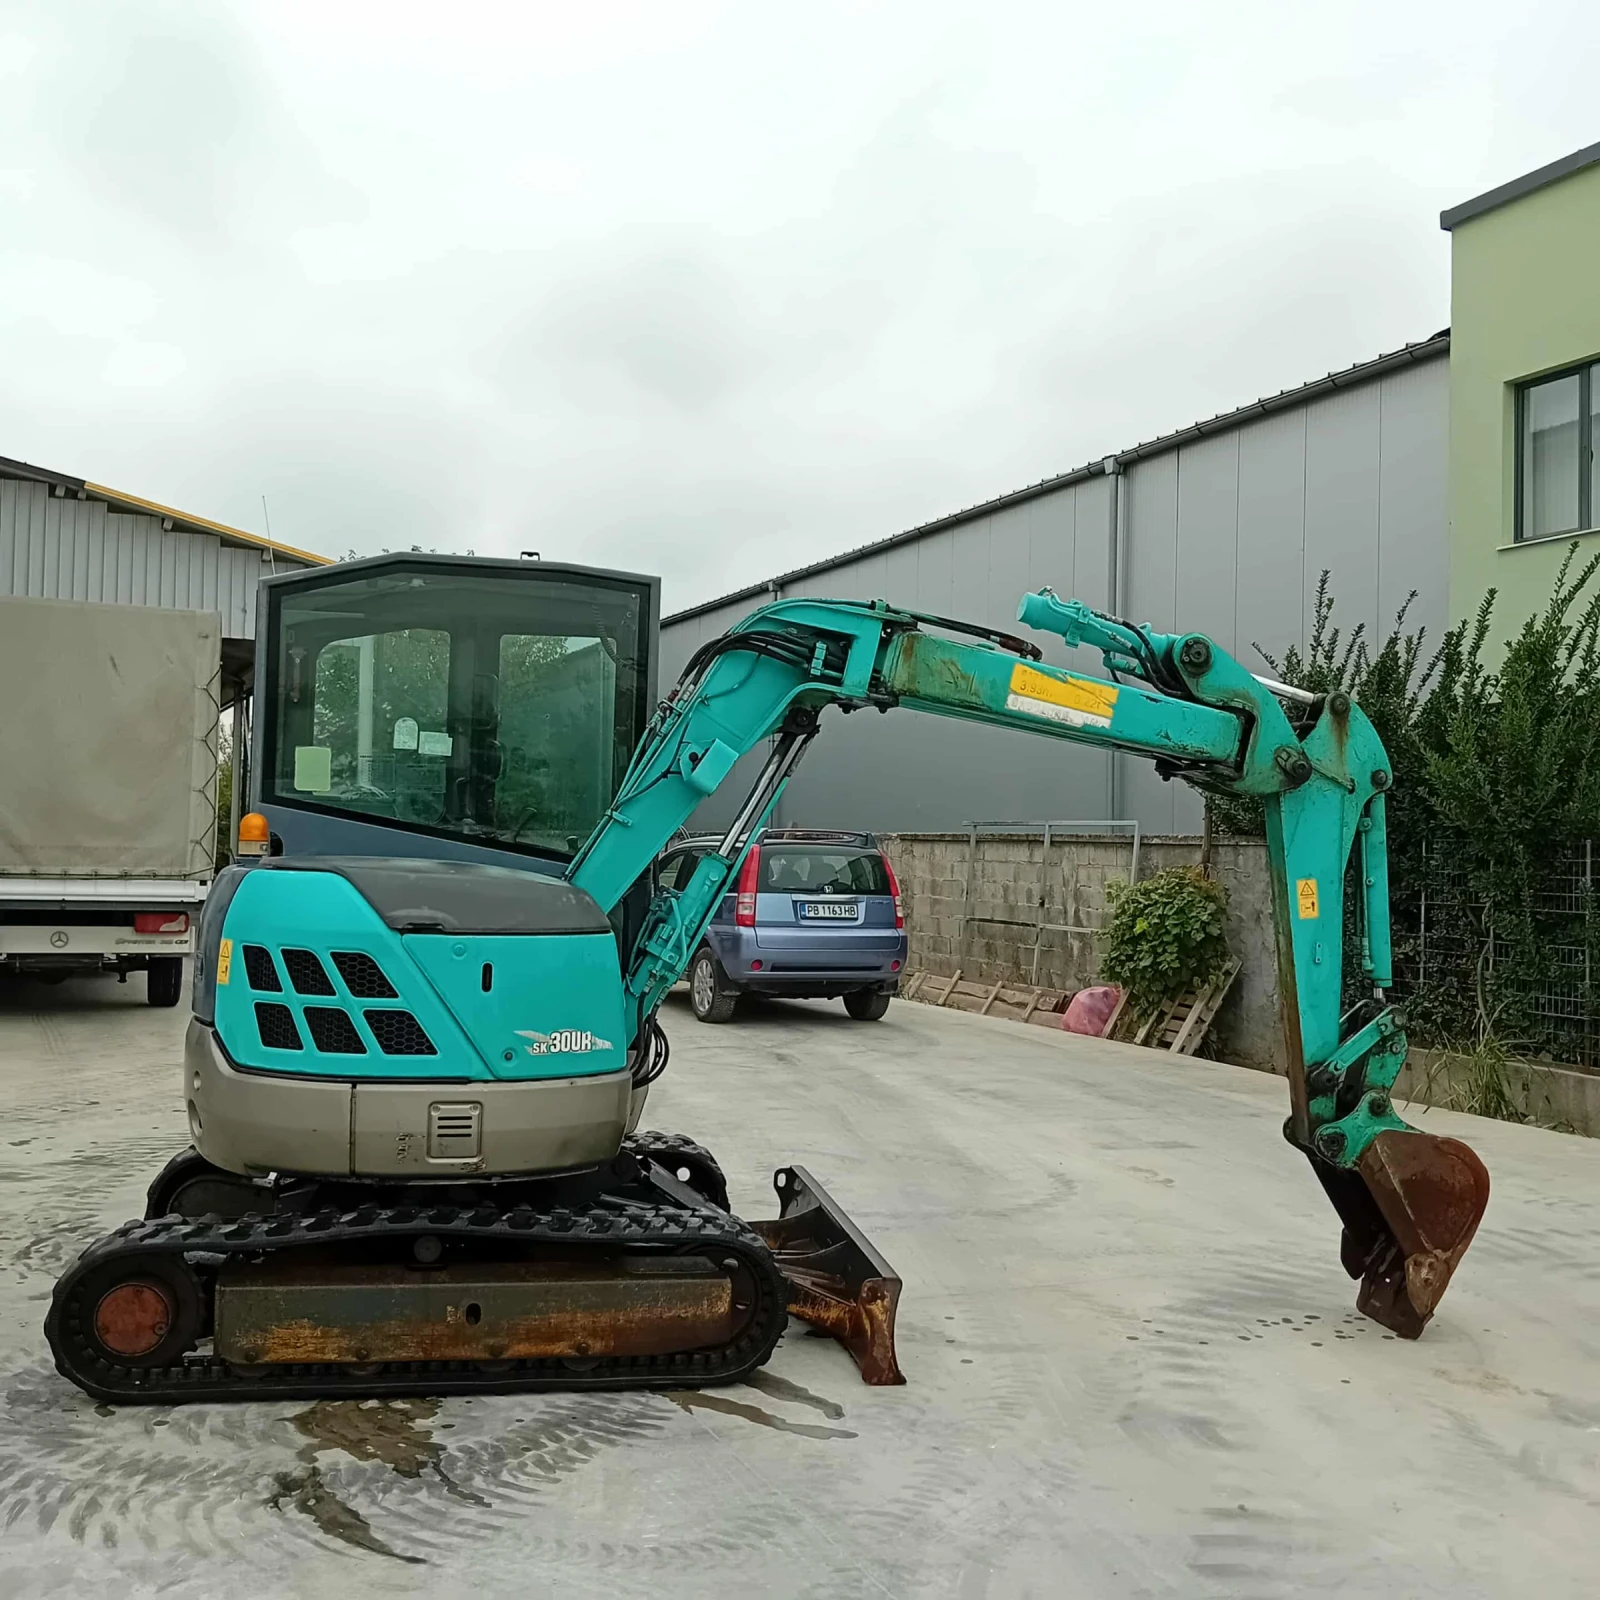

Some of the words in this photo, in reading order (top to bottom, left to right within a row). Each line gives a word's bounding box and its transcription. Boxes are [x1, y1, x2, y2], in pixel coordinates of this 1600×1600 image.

[807, 905, 819, 915] PB
[822, 906, 843, 916] 1163
[844, 906, 856, 916] HB
[532, 1042, 548, 1054] SK
[550, 1031, 593, 1053] 30UR
